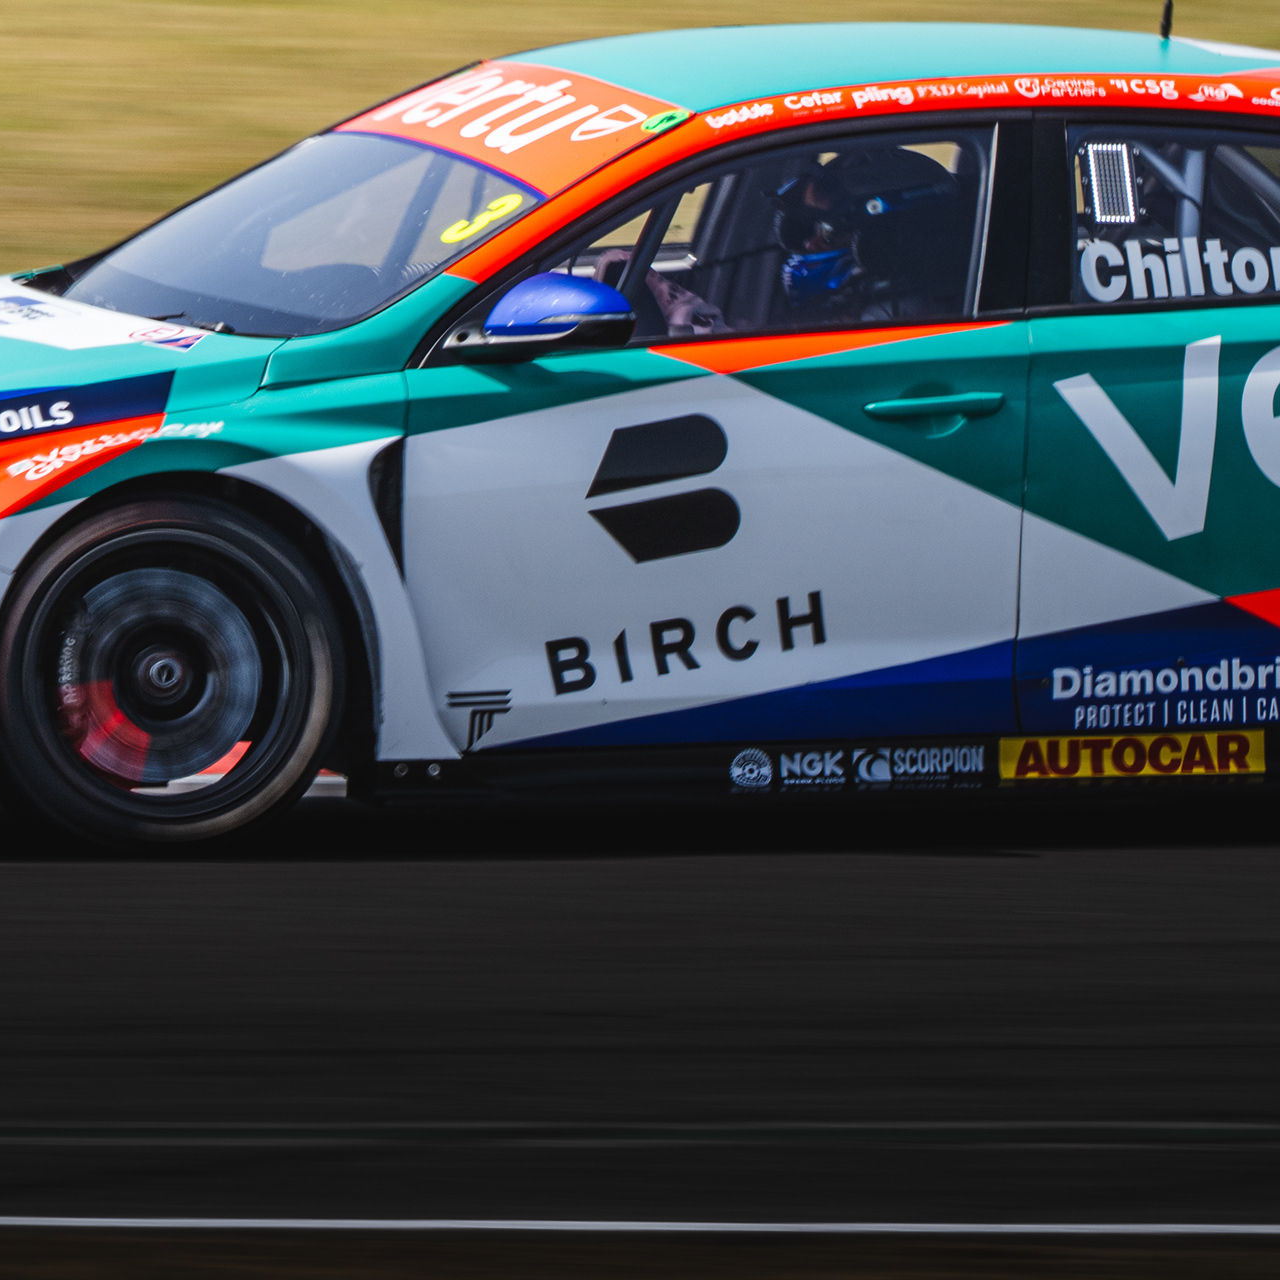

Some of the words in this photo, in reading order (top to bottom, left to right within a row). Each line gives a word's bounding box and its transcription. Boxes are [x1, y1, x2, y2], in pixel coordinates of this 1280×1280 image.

[957, 80, 1009, 99] Capital
[1041, 85, 1106, 98] Partners
[440, 194, 523, 244] 3
[544, 590, 827, 697] BIRCH
[1074, 701, 1156, 730] PROTECT
[1177, 698, 1234, 725] CLEAN
[780, 750, 845, 778] NGK
[893, 745, 985, 775] SCORPION
[1015, 733, 1251, 778] AUTOCAR
